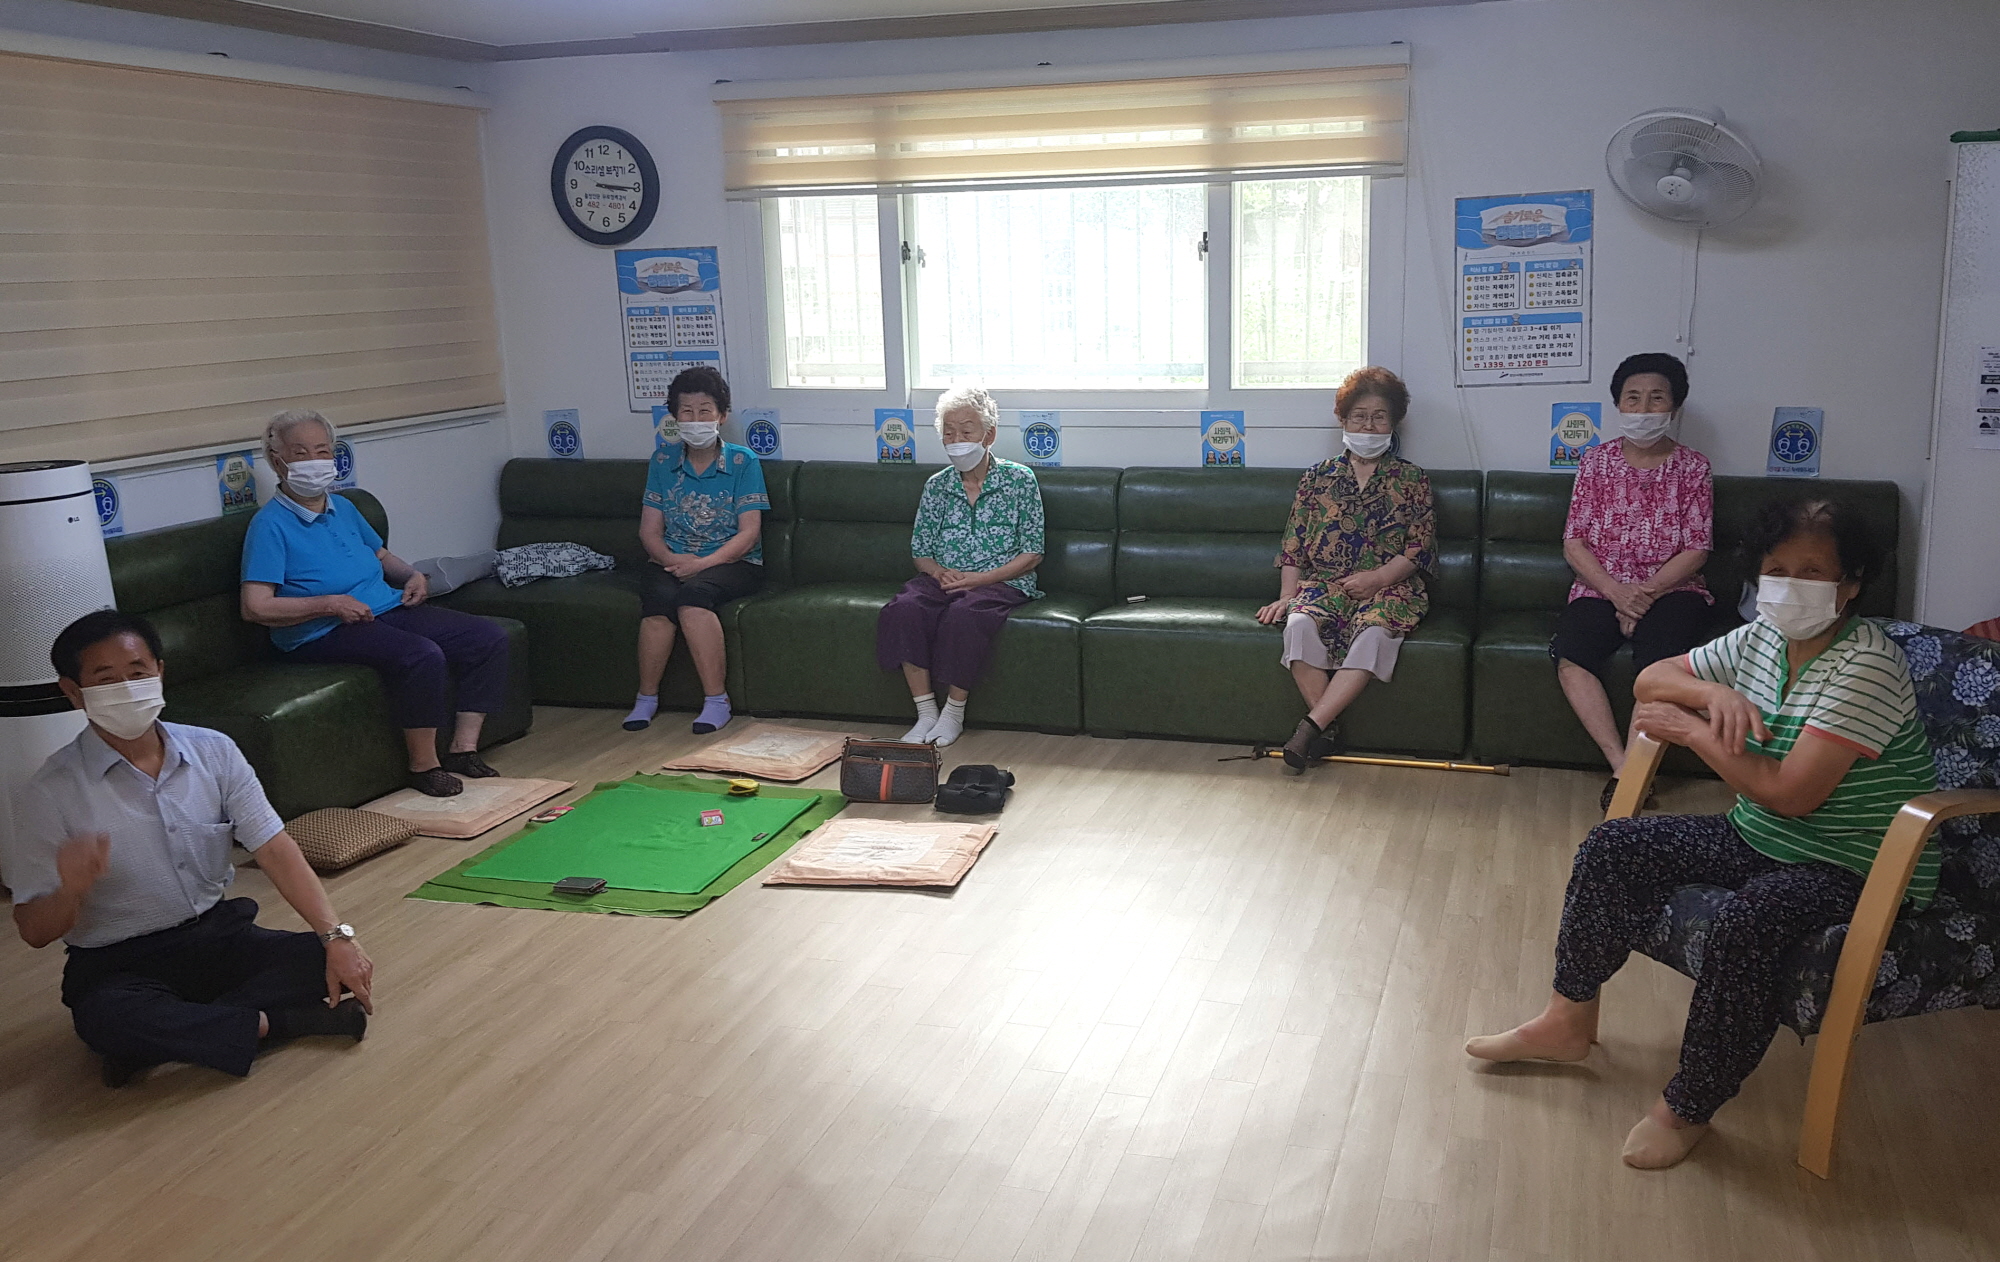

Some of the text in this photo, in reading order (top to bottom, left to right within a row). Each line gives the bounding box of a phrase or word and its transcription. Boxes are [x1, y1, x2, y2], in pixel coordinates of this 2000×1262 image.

[585, 148, 594, 158] 11
[598, 145, 610, 155] 12
[617, 150, 622, 159] 1
[574, 161, 585, 170] 10
[628, 163, 636, 173] 2
[570, 179, 578, 189] 9
[633, 182, 640, 192] 3
[575, 197, 583, 207] 8
[629, 200, 636, 210] 4
[587, 211, 595, 221] 7
[618, 213, 625, 222] 5
[603, 217, 610, 227] 6
